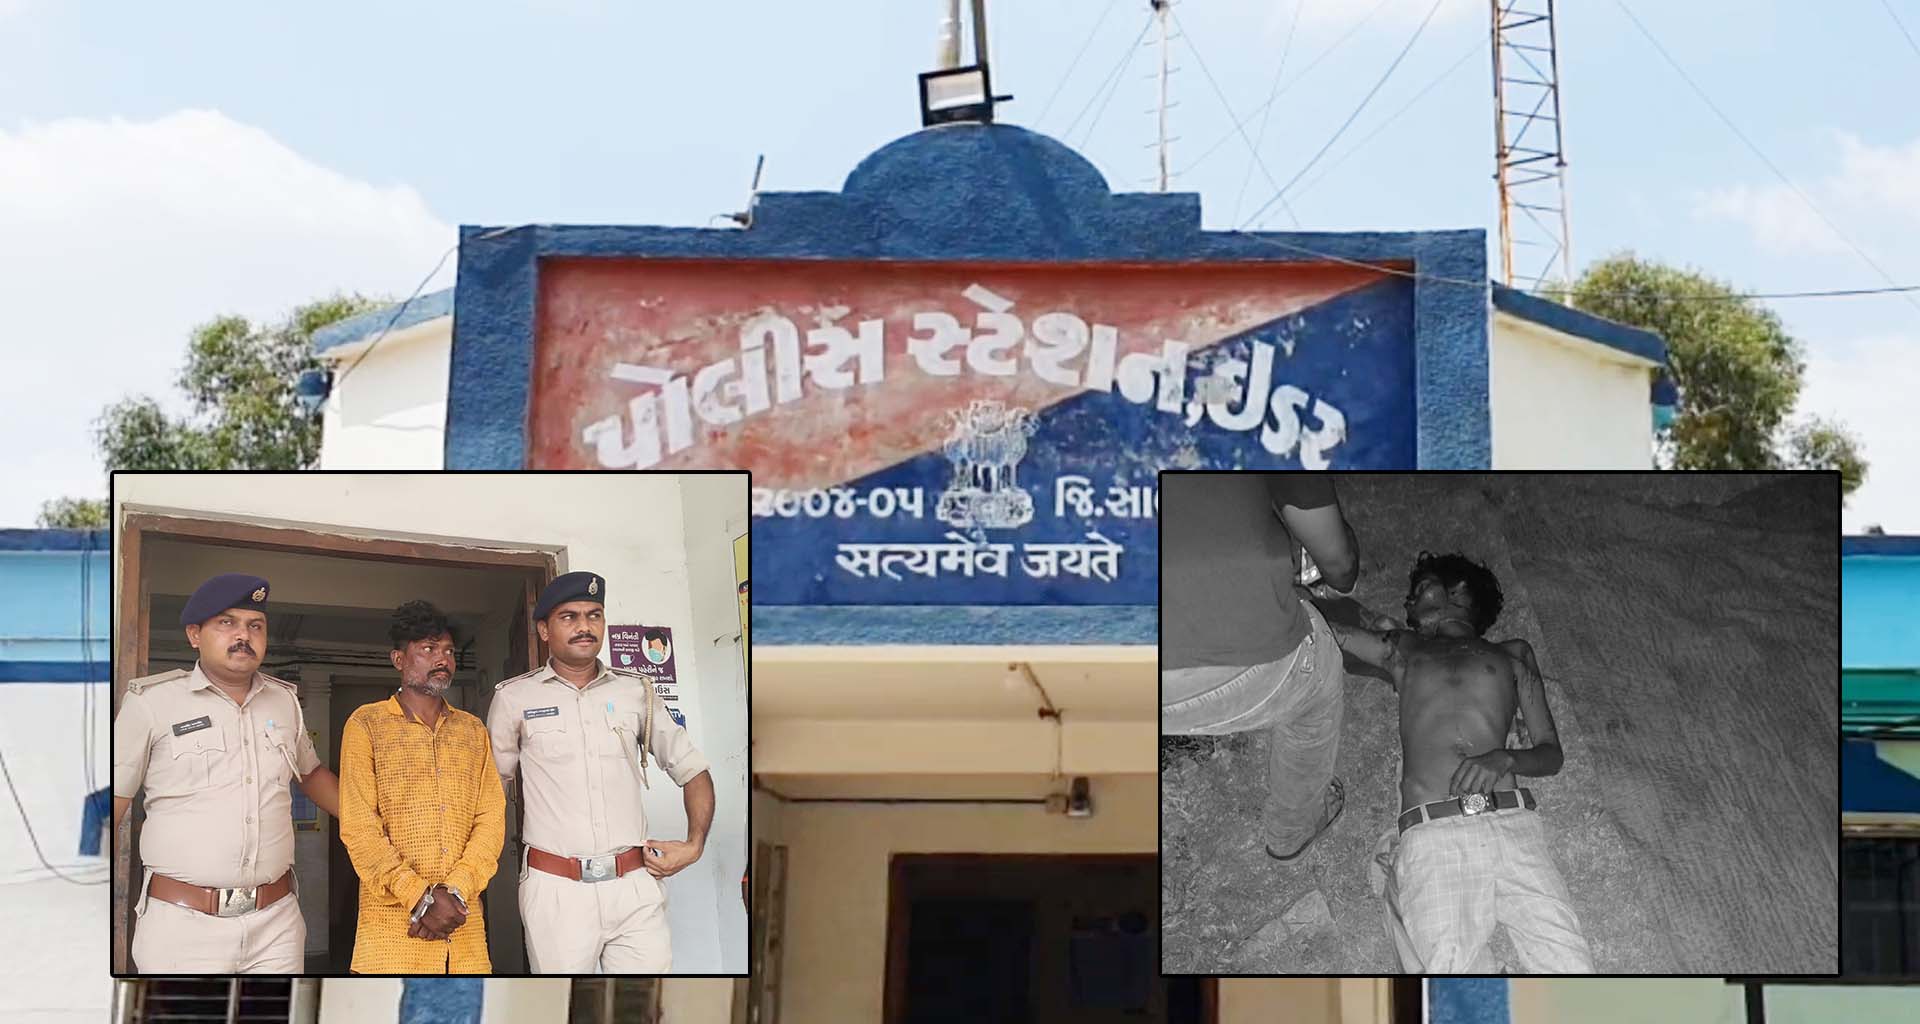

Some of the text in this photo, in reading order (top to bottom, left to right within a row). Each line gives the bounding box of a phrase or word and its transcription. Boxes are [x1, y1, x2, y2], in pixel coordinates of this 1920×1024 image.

[583, 310, 885, 470] પોલીસ
[1055, 475, 1158, 518] જિ.સા
[1020, 531, 1123, 582] जयते
